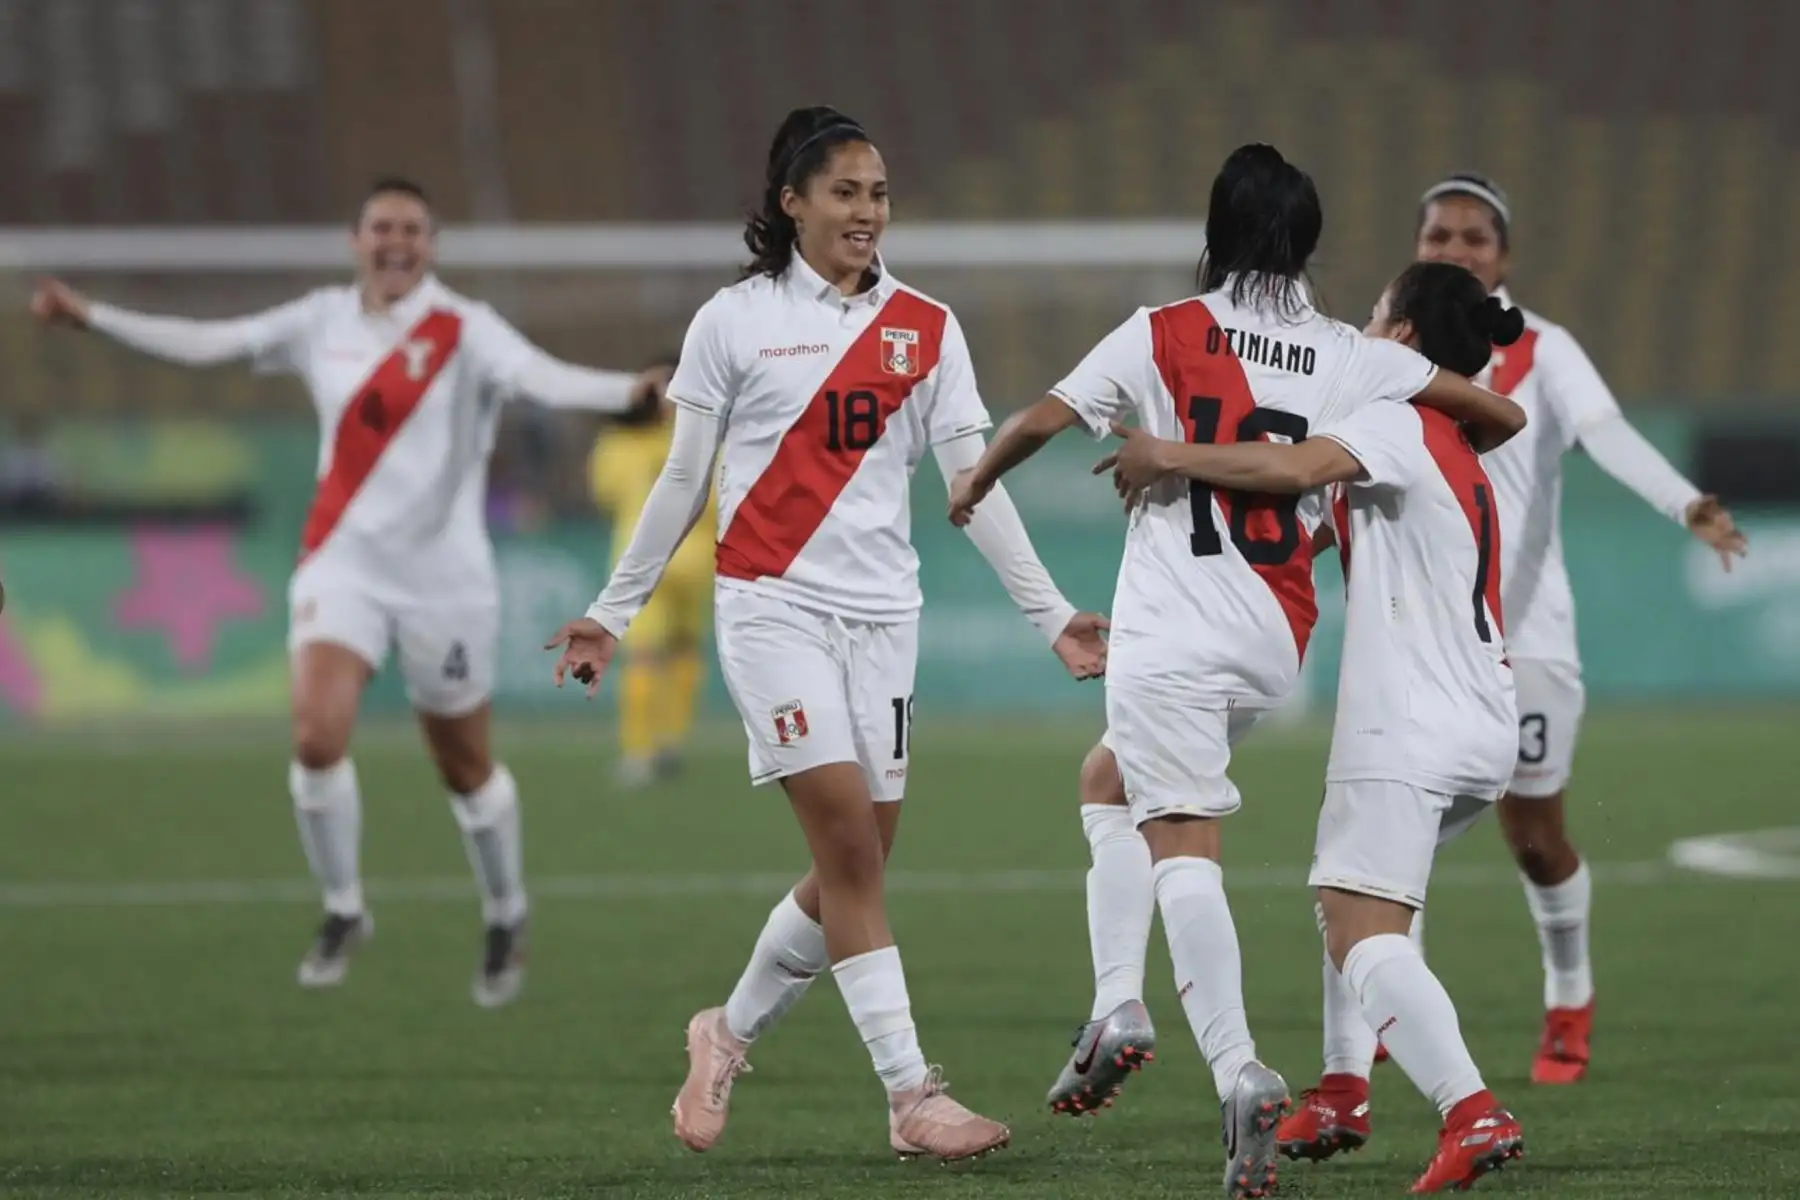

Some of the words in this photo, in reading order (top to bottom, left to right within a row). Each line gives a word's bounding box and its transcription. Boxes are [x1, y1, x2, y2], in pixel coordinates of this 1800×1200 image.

[759, 342, 829, 358] marathon
[885, 330, 914, 341] PERU
[1206, 326, 1317, 376] OTINIANO
[825, 389, 880, 451] 18
[1519, 713, 1546, 764] 3
